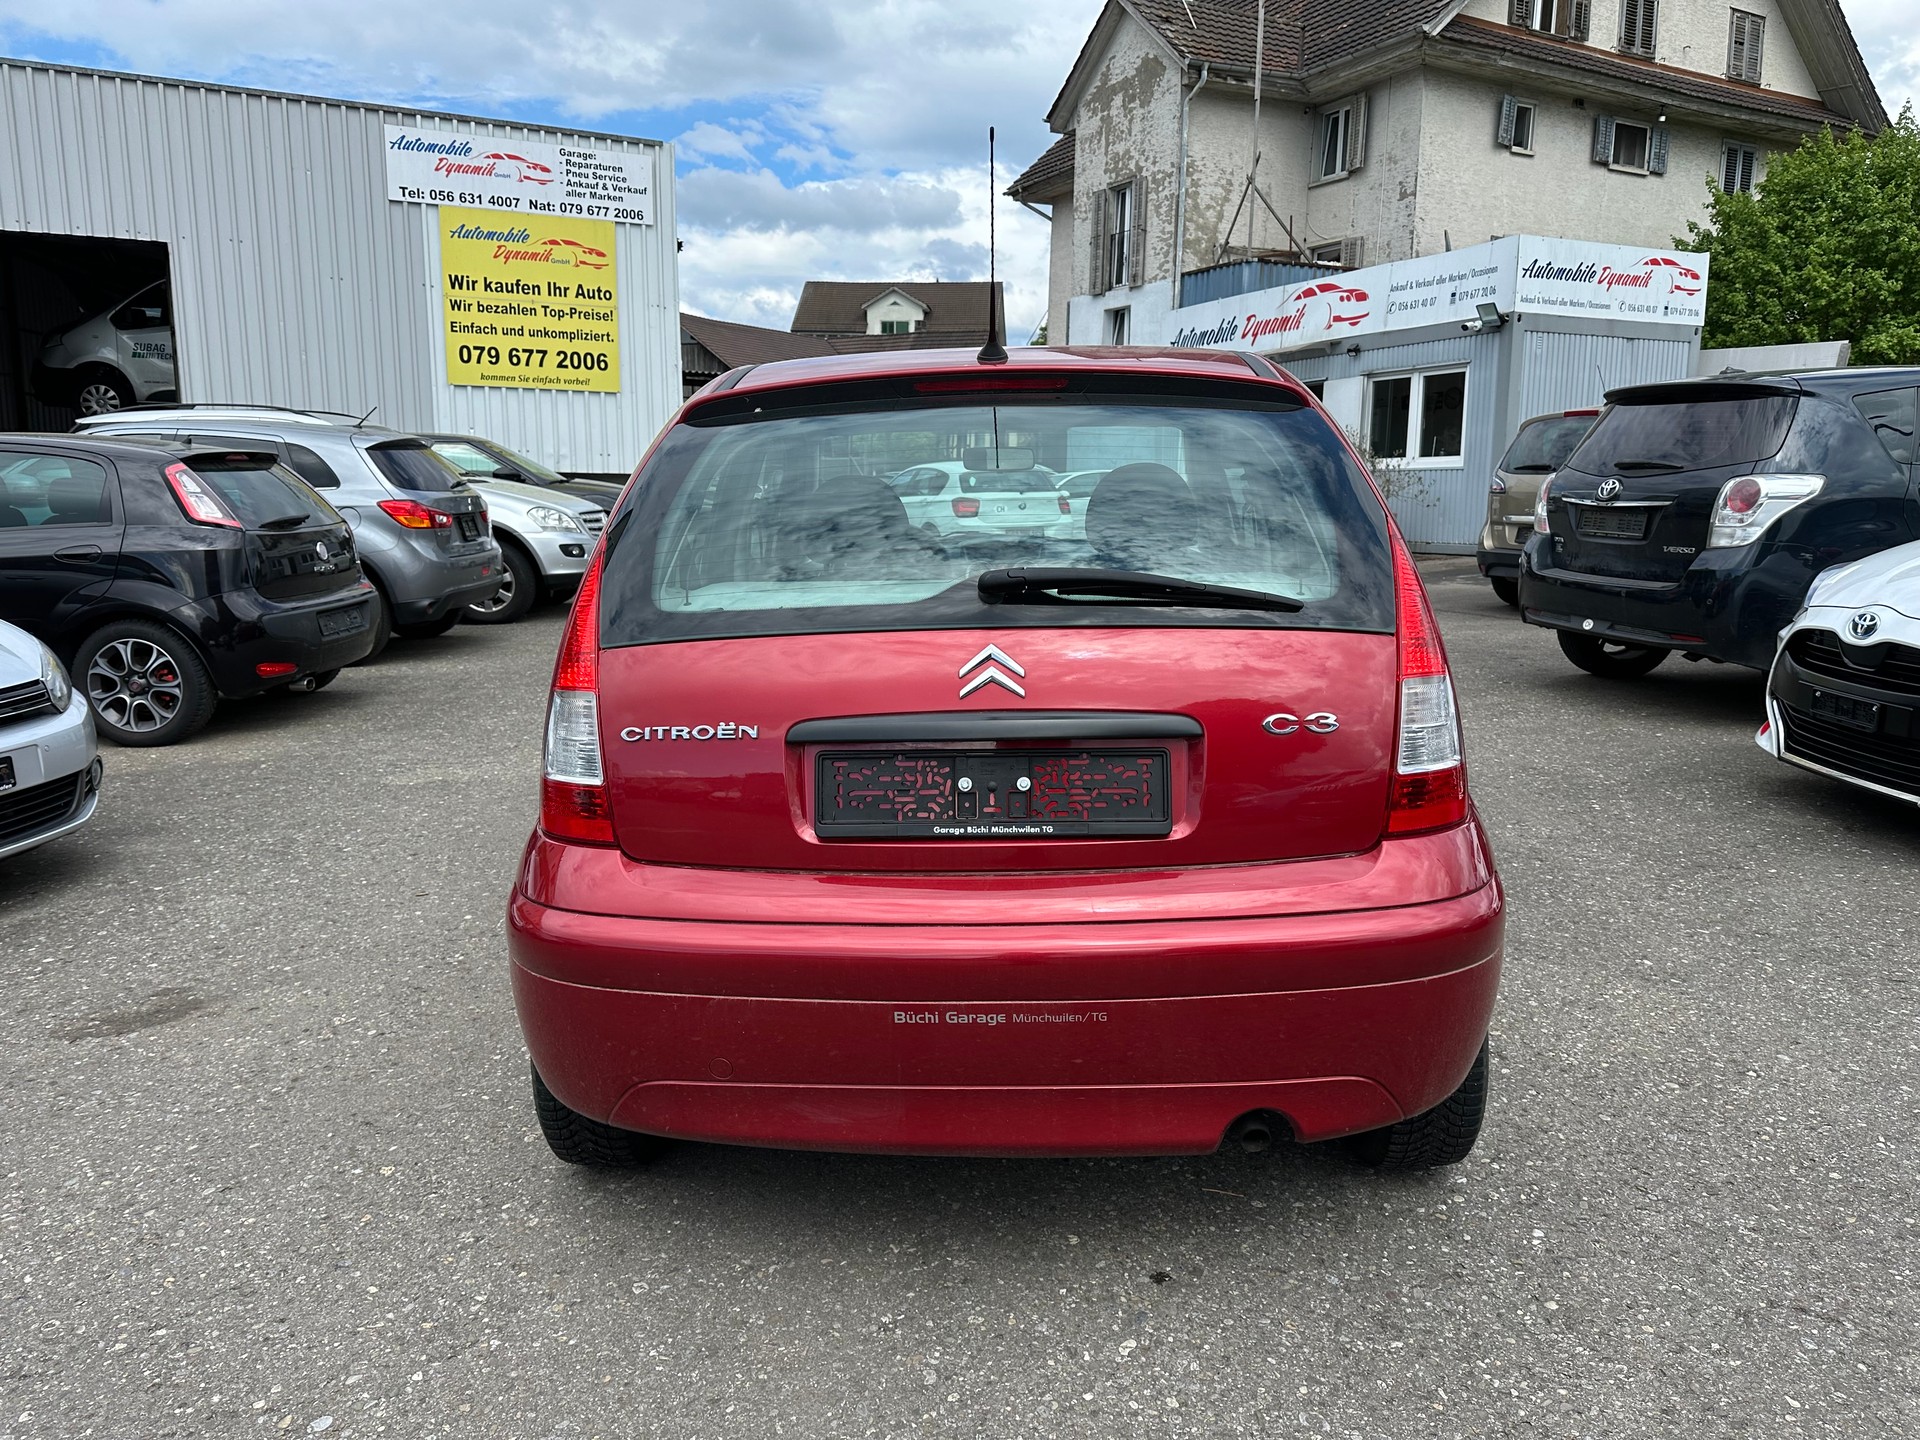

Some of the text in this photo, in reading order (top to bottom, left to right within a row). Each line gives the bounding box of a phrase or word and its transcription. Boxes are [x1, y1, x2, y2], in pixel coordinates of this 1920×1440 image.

[389, 134, 473, 158] Automobile
[559, 148, 597, 161] Garage:
[434, 157, 511, 179] Dynamik GmbH
[565, 159, 623, 173] Reparaturen
[566, 169, 589, 179] Pneu
[591, 171, 627, 183] Service
[565, 190, 624, 203] aller Marken
[566, 180, 600, 191] Ankauf
[601, 183, 608, 191] &
[611, 184, 648, 195] Verkauf
[399, 186, 644, 220] Tel: 056 631 4007 Nat: 079 677 2006
[449, 223, 530, 244] Automobile
[493, 245, 553, 264] Dynamik
[1390, 283, 1408, 293] Ankauf
[1415, 276, 1436, 289] Verkauf
[1522, 258, 1653, 292] Automobile Dynamik
[448, 274, 613, 301] Wir kaufen Ihr Auto
[1398, 302, 1408, 311] 056
[1410, 299, 1419, 310] 631
[1421, 298, 1428, 308] 40
[1429, 296, 1437, 306] 07
[1458, 291, 1469, 301] 079
[1470, 288, 1480, 299] 677
[1489, 285, 1496, 296] 06
[449, 299, 614, 322] Wir bezahlen Top-Preise!
[450, 321, 614, 343] Einfach und unkompliziert.
[1170, 303, 1307, 347] Automobile Dynamik
[133, 342, 165, 352] SUBAG
[458, 344, 609, 371] 079 677 2006
[480, 372, 590, 386] kommen Sie einfach vorbei!
[1662, 546, 1696, 554] VERSO
[620, 721, 759, 741] CITROËN
[933, 826, 965, 835] Garage
[967, 825, 989, 833] Büchi
[991, 825, 1040, 833] Münchwilen
[894, 1011, 939, 1024] Büchi
[945, 1012, 1006, 1026] Garage
